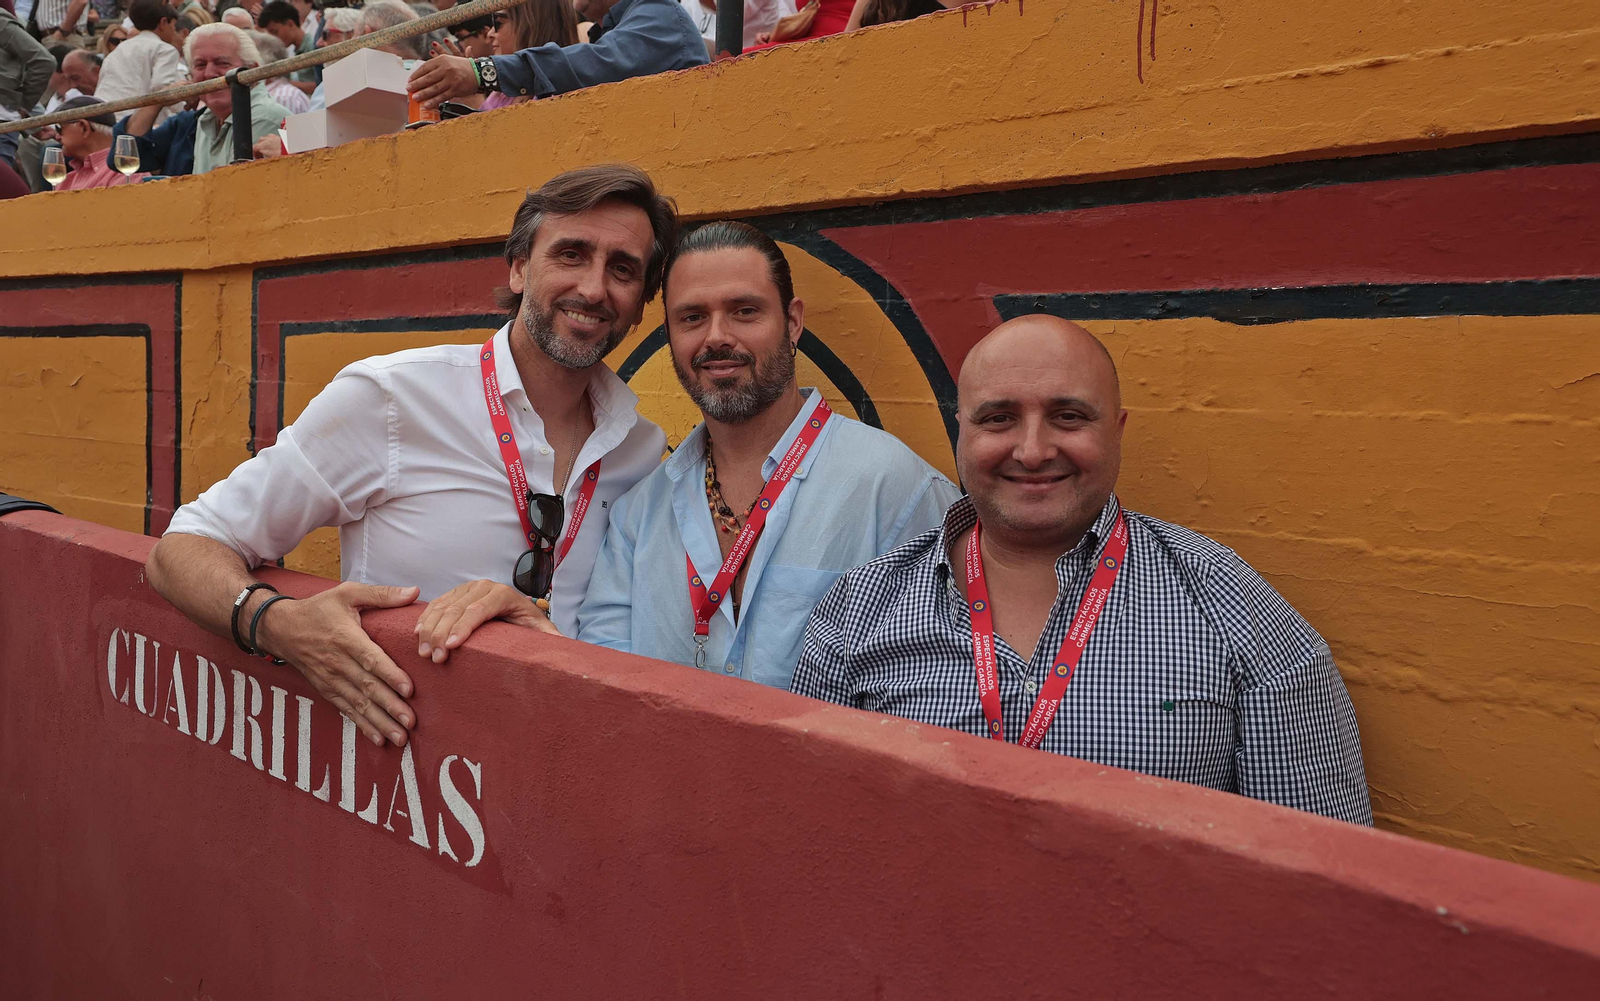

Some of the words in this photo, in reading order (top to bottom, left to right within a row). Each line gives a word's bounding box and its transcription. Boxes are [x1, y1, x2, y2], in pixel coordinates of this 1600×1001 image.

[486, 377, 498, 416] ESPECTÁCULOS
[494, 390, 505, 416] CARMELO
[781, 444, 808, 481] ESPECTÁCULOS
[786, 438, 803, 460] CARMELO
[509, 464, 525, 510] ESPECTÁCULOS
[514, 459, 525, 482] GARCÍA
[773, 460, 788, 480] GARCÍA
[574, 493, 584, 518] CARMELO
[729, 530, 755, 574] ESPECTÁCULOS
[734, 524, 751, 552] CARMELO
[721, 552, 736, 572] GARCÍA
[1070, 588, 1098, 640] ESPECTÁCULOS
[1076, 614, 1096, 648] CARMELO
[1092, 588, 1108, 614] GARCÍA
[974, 632, 984, 666] CARMELO
[982, 635, 994, 690] ESPECTÁCULOS
[978, 668, 988, 697] GARCÍA
[1022, 698, 1048, 747] PECTÁCULOS
[1030, 728, 1044, 748] MELO
[1042, 699, 1058, 727] GARCÍA
[107, 627, 485, 867] CUADRILLAS
